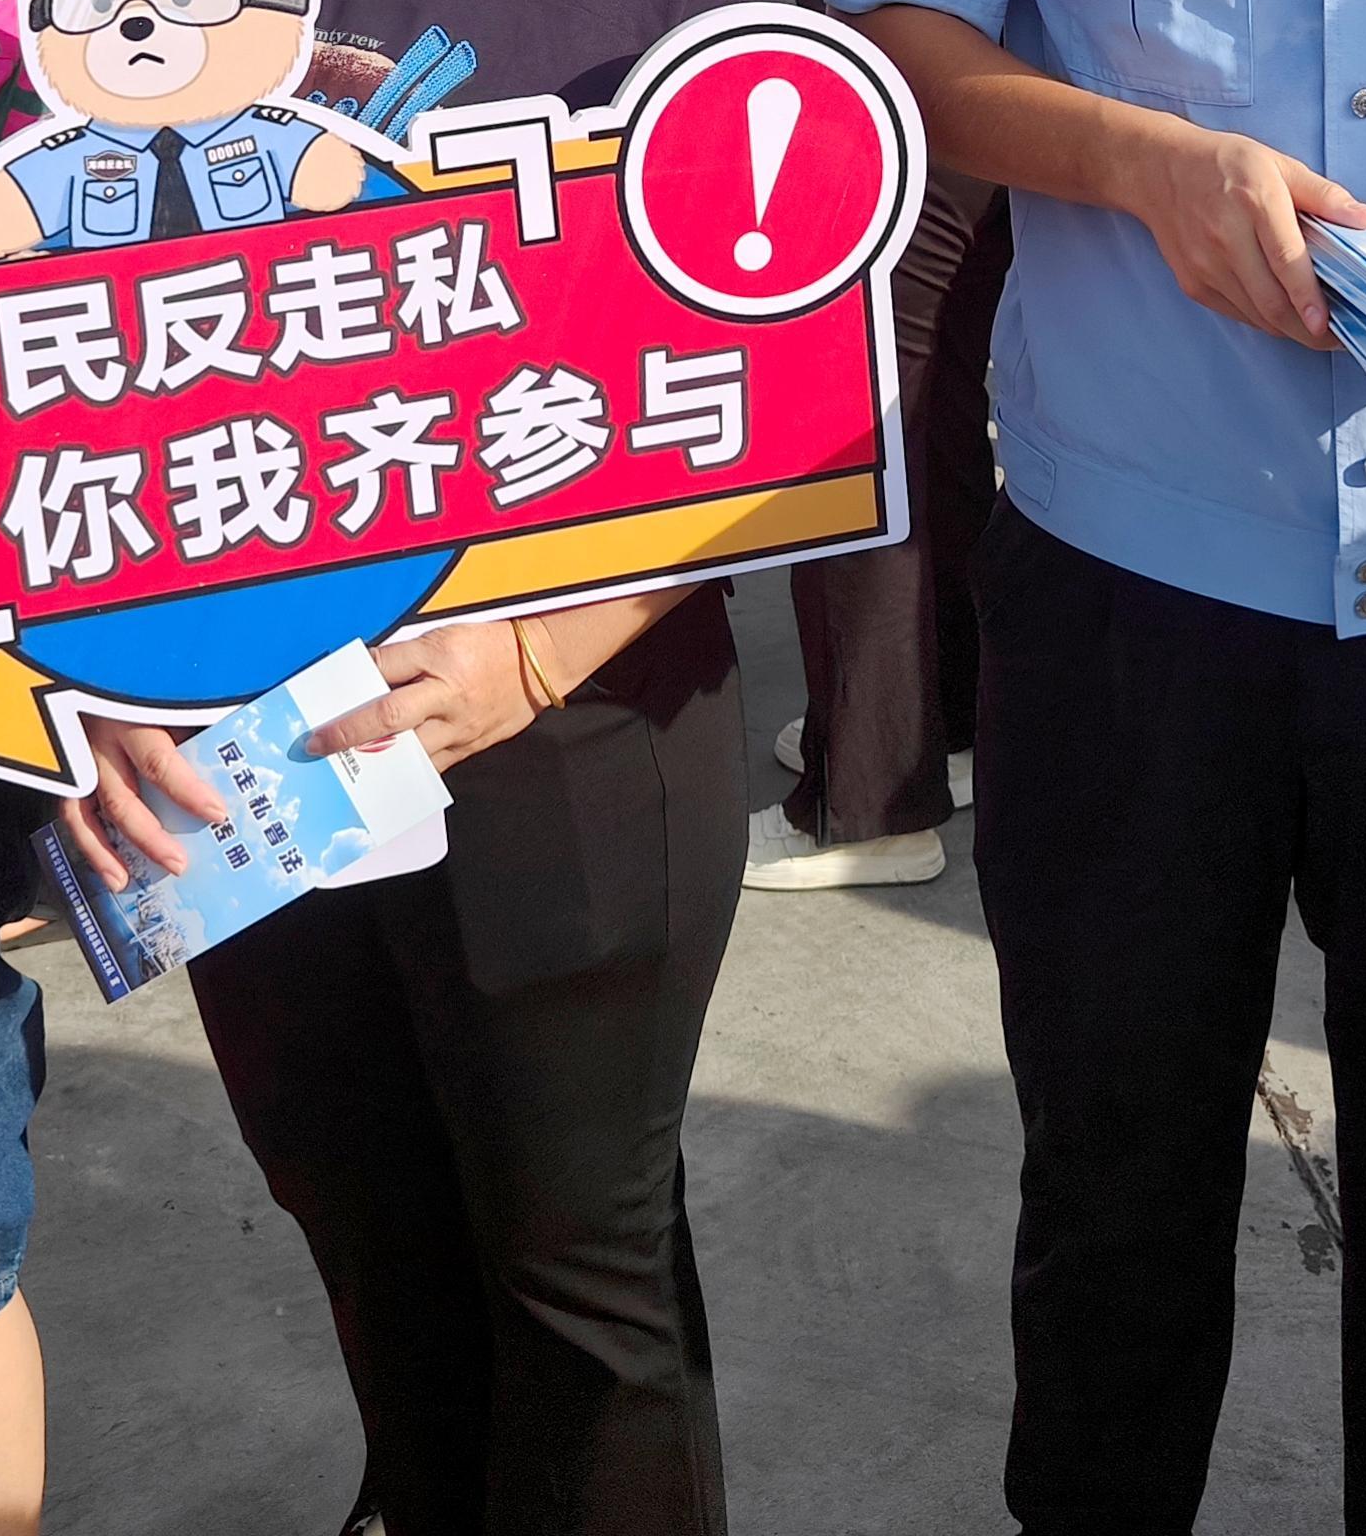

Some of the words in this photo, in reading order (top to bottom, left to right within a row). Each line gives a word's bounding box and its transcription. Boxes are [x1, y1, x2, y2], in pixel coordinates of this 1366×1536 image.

[207, 138, 255, 164] 000110
[4, 350, 746, 588] 你我齐参与
[217, 738, 308, 876] 反走私普法
